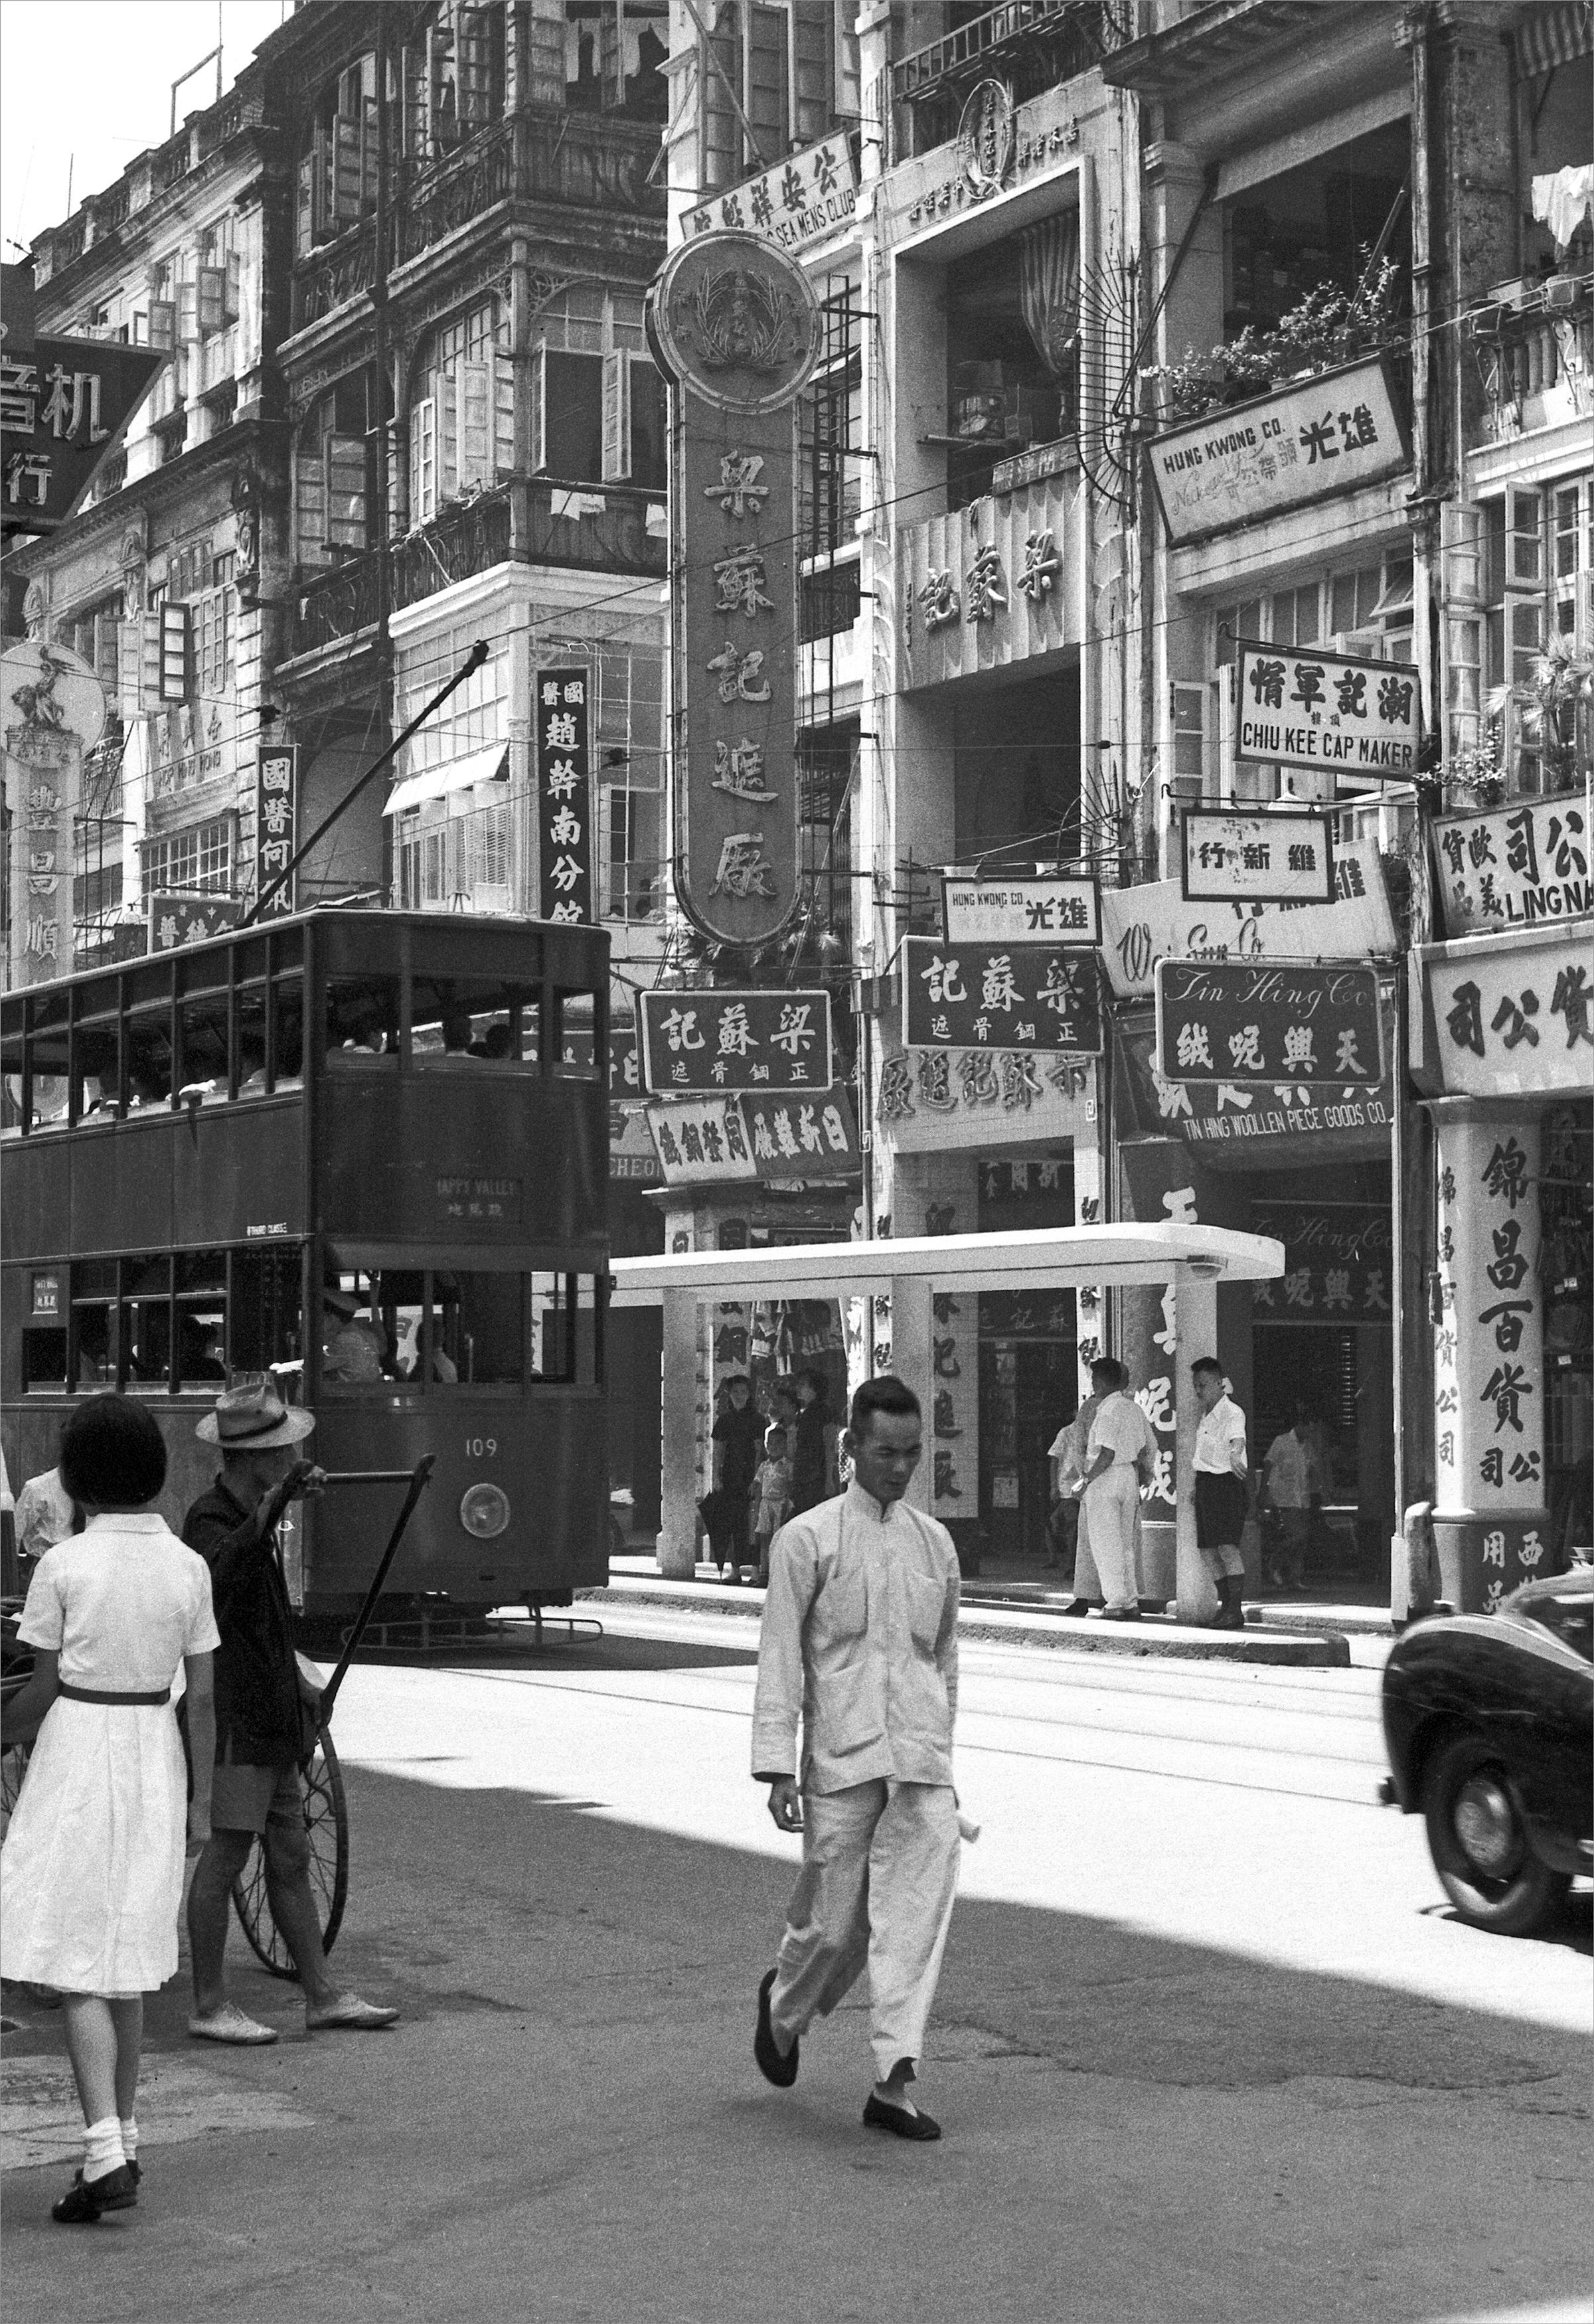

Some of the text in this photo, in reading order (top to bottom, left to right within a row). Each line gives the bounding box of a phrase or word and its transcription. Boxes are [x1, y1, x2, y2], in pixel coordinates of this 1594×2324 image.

[775, 221, 798, 247] SEA
[827, 189, 856, 222] CLUB
[1163, 446, 1203, 474] HUNG
[1204, 427, 1257, 460] KWONG
[1243, 722, 1413, 768] CHIU KEE CAP MAKER
[24, 786, 63, 961] 豐昌順
[1199, 841, 1316, 872] 維新行
[952, 892, 975, 906] HUNG
[977, 892, 1008, 907] KWONG
[920, 955, 1085, 1015] 梁蘇記
[1164, 967, 1228, 1001] Tin
[1235, 969, 1323, 1019] Hing
[659, 1003, 817, 1056] 梁蘇記
[1183, 1119, 1203, 1141] TIN
[1202, 1116, 1231, 1139] HING
[1230, 1110, 1287, 1137] WOOLLEN
[1287, 1108, 1322, 1132] PIECE
[1324, 1103, 1365, 1129] GOODS
[465, 1438, 498, 1457] 109
